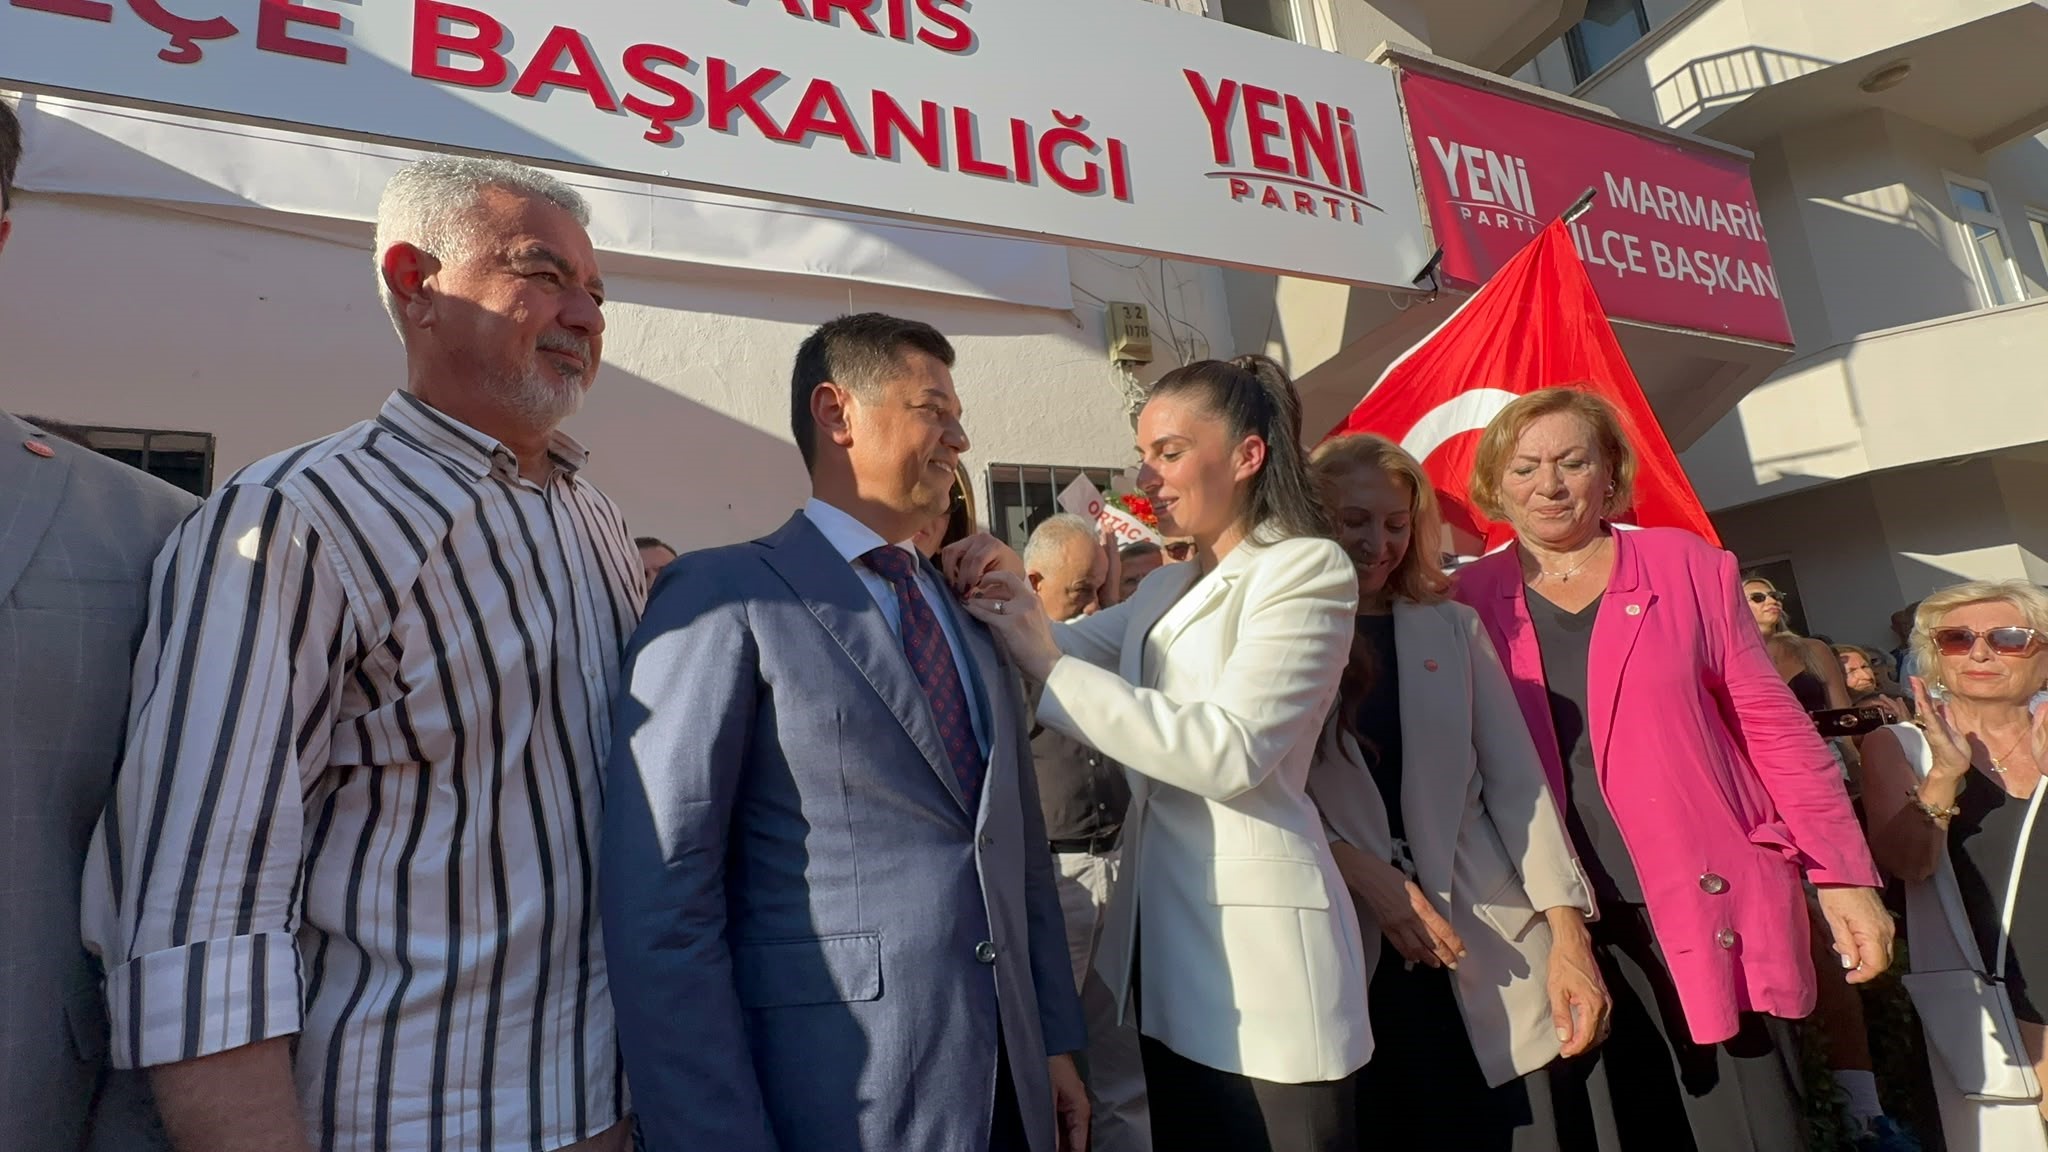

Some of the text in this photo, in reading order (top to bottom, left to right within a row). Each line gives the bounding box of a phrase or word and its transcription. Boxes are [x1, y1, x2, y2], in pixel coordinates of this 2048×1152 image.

[411, 0, 1128, 201] BAŞKANLIĞI
[1650, 240, 1779, 299] BAŞKAN
[1088, 500, 1152, 543] ORTAC
